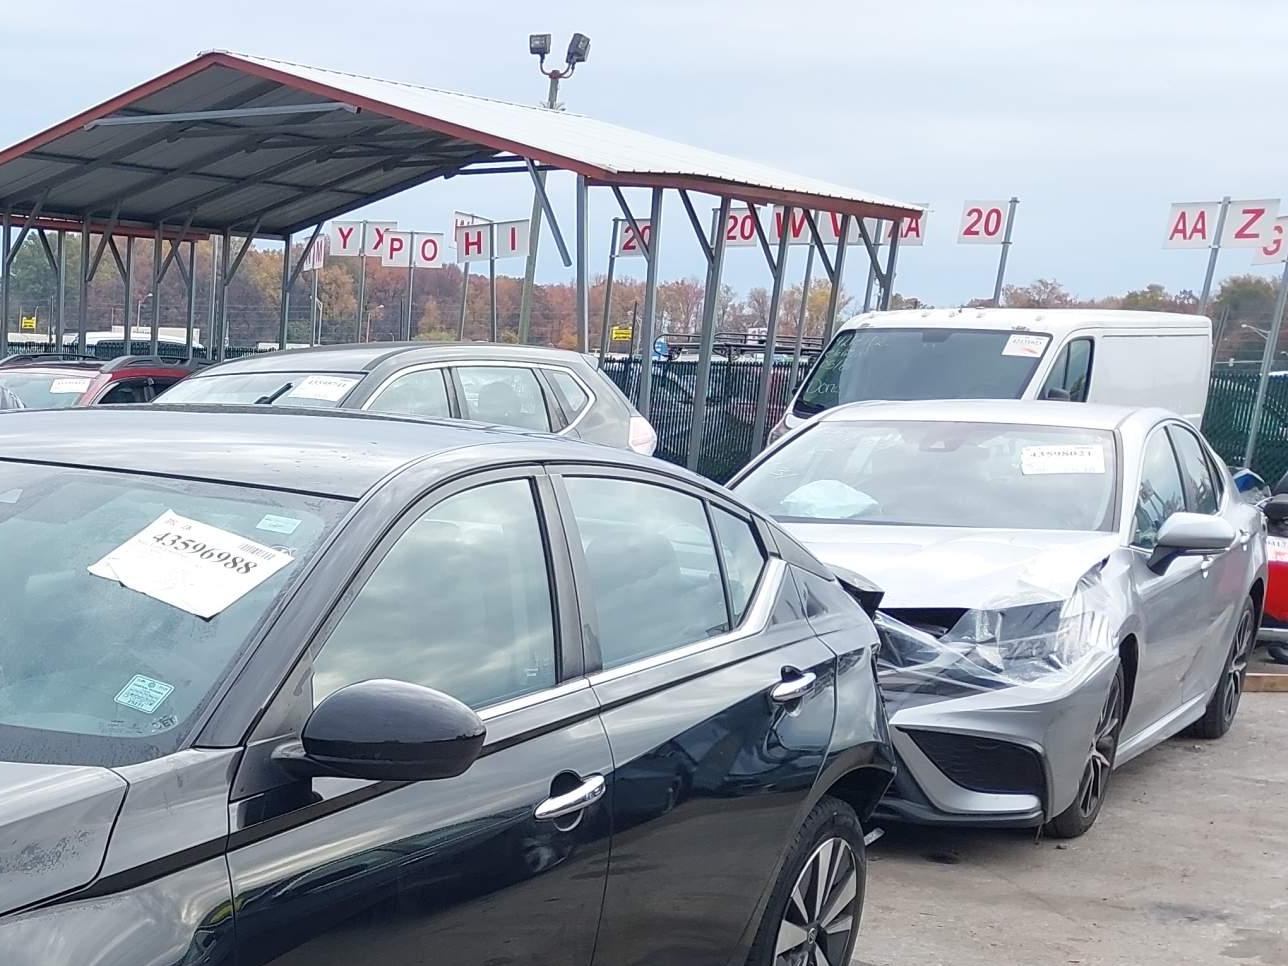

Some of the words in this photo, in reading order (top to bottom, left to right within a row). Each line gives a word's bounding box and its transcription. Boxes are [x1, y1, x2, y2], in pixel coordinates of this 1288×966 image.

[726, 214, 755, 240] 20
[962, 208, 1002, 236] 20
[1169, 210, 1207, 240] AA
[1234, 208, 1265, 239] Z
[338, 227, 353, 249] Y
[389, 237, 404, 260] P
[464, 230, 482, 256] H
[153, 532, 258, 575] 43596988
